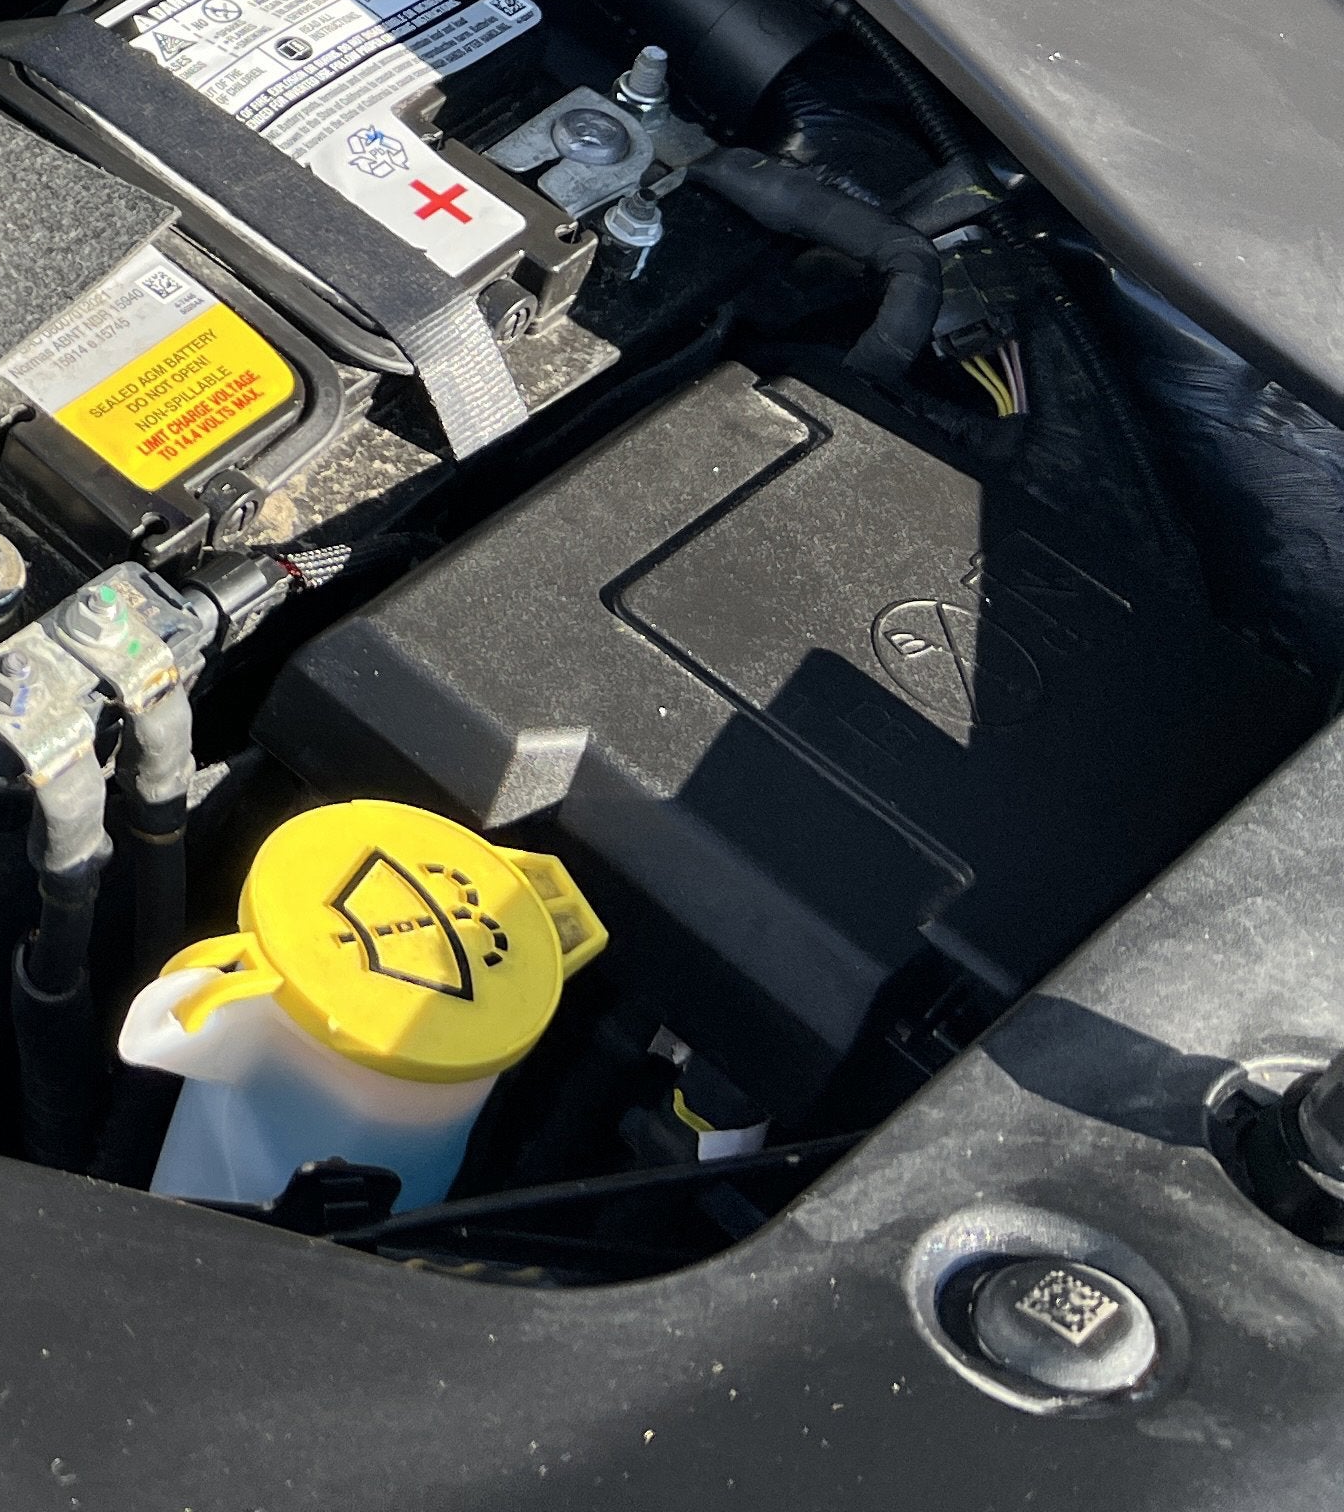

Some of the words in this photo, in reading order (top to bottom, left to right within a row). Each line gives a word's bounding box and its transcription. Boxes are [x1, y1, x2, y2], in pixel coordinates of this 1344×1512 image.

[190, 18, 208, 30] NO
[214, 78, 227, 90] OF
[223, 68, 243, 82] THE
[8, 348, 54, 379] Normas
[52, 325, 85, 352] ABNT
[109, 288, 144, 312] 15940
[52, 344, 88, 370] 15914
[94, 317, 130, 342] 15745
[88, 383, 139, 418] SEALED
[137, 364, 167, 386] AGM
[163, 328, 216, 368] BATTERY
[125, 397, 148, 413] DO
[144, 379, 172, 400] NOT
[170, 354, 209, 383] OPEN!
[135, 365, 231, 431] NON-SPILLABLE
[137, 428, 169, 455] LIMIT
[167, 401, 212, 434] CHARGE
[209, 370, 258, 405] VOLTAGE
[157, 445, 178, 460] TO
[174, 428, 202, 449] 14.4
[197, 405, 235, 432] VOLTS
[231, 388, 261, 409] MAX.
